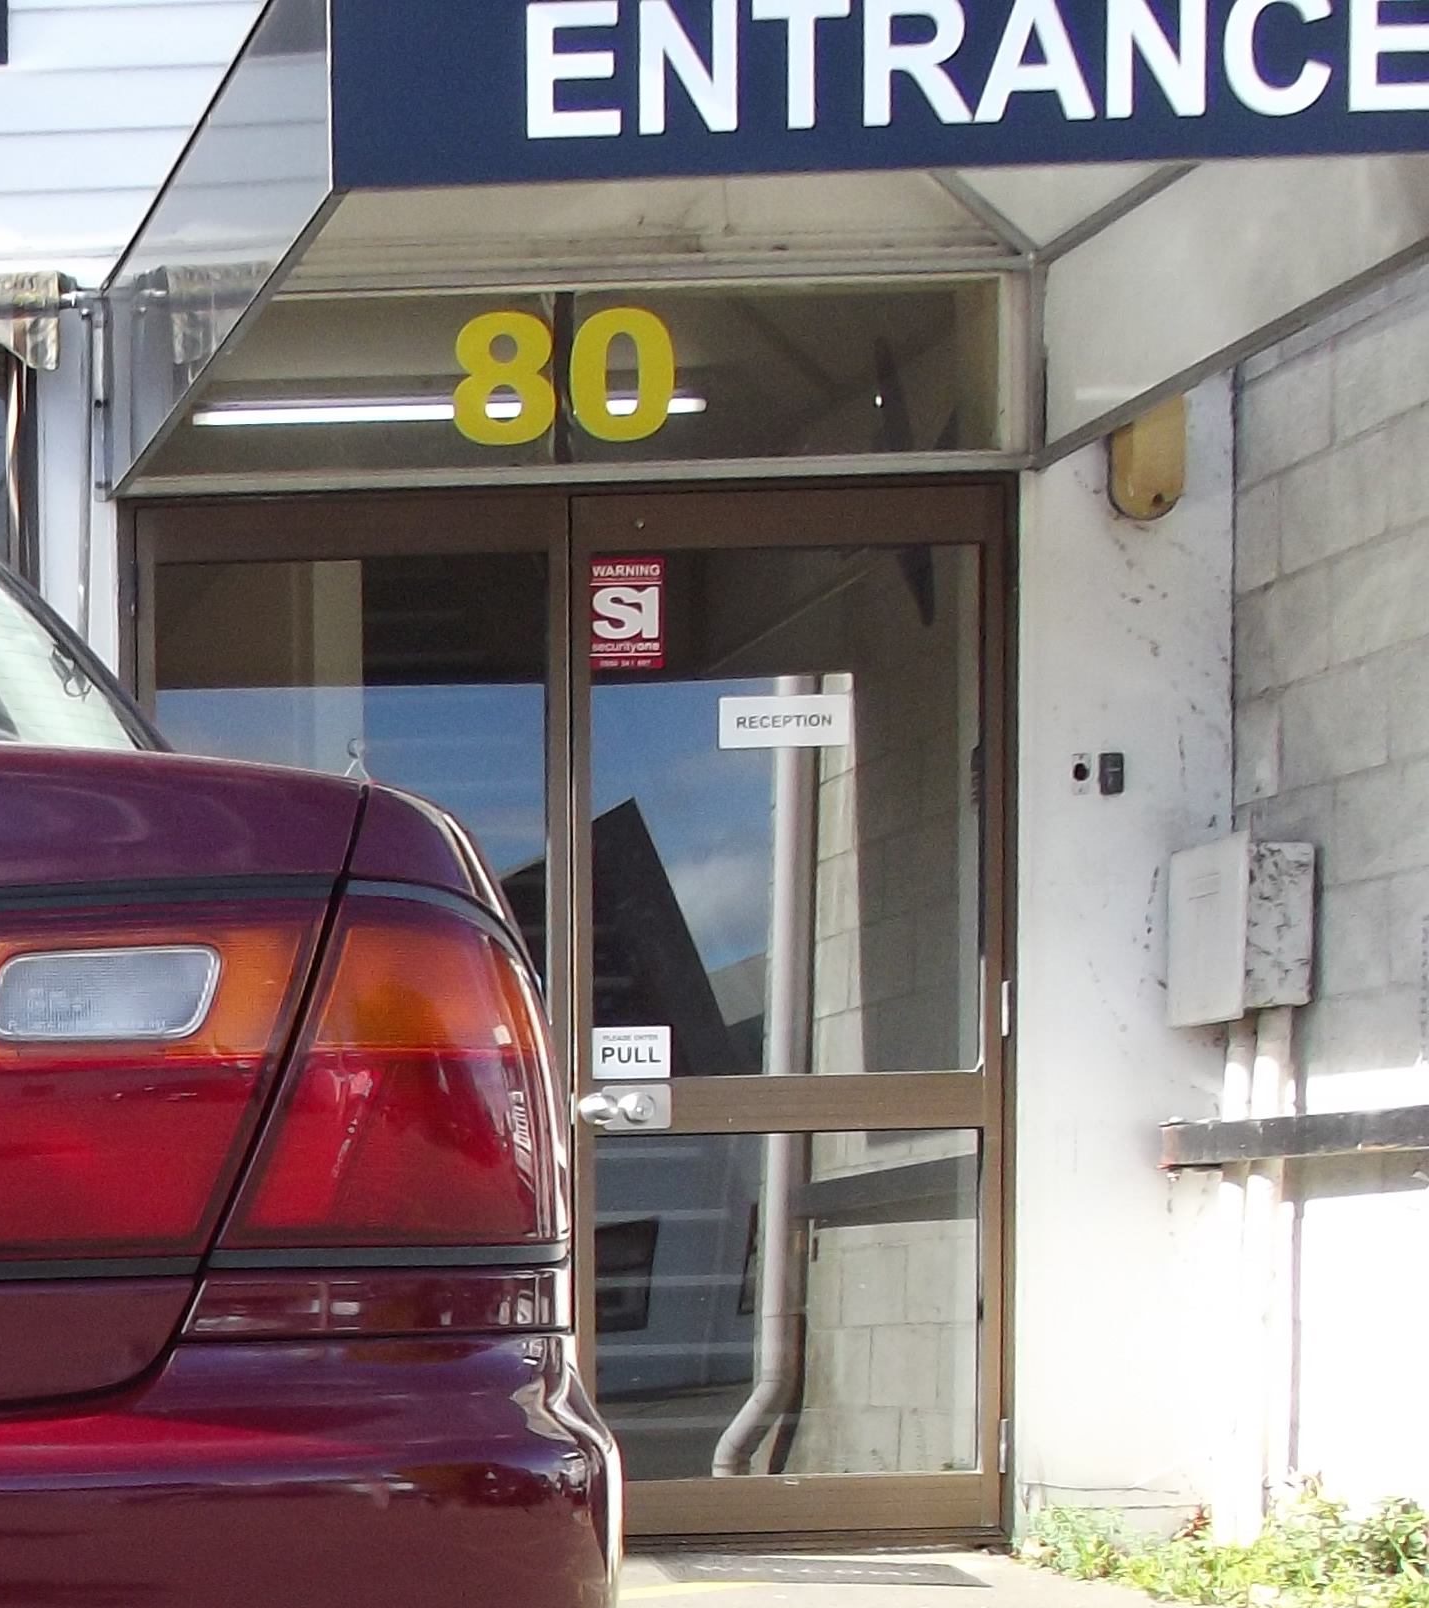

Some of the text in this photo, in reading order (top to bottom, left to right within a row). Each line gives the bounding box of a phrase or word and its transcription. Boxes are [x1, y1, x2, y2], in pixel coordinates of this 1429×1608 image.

[525, 0, 1429, 138] ENTRANCE
[452, 307, 675, 446] 80
[592, 564, 661, 577] WARNING
[735, 713, 833, 730] RECEPTION
[602, 1034, 632, 1042] PLEASE
[600, 1046, 662, 1064] PULL
